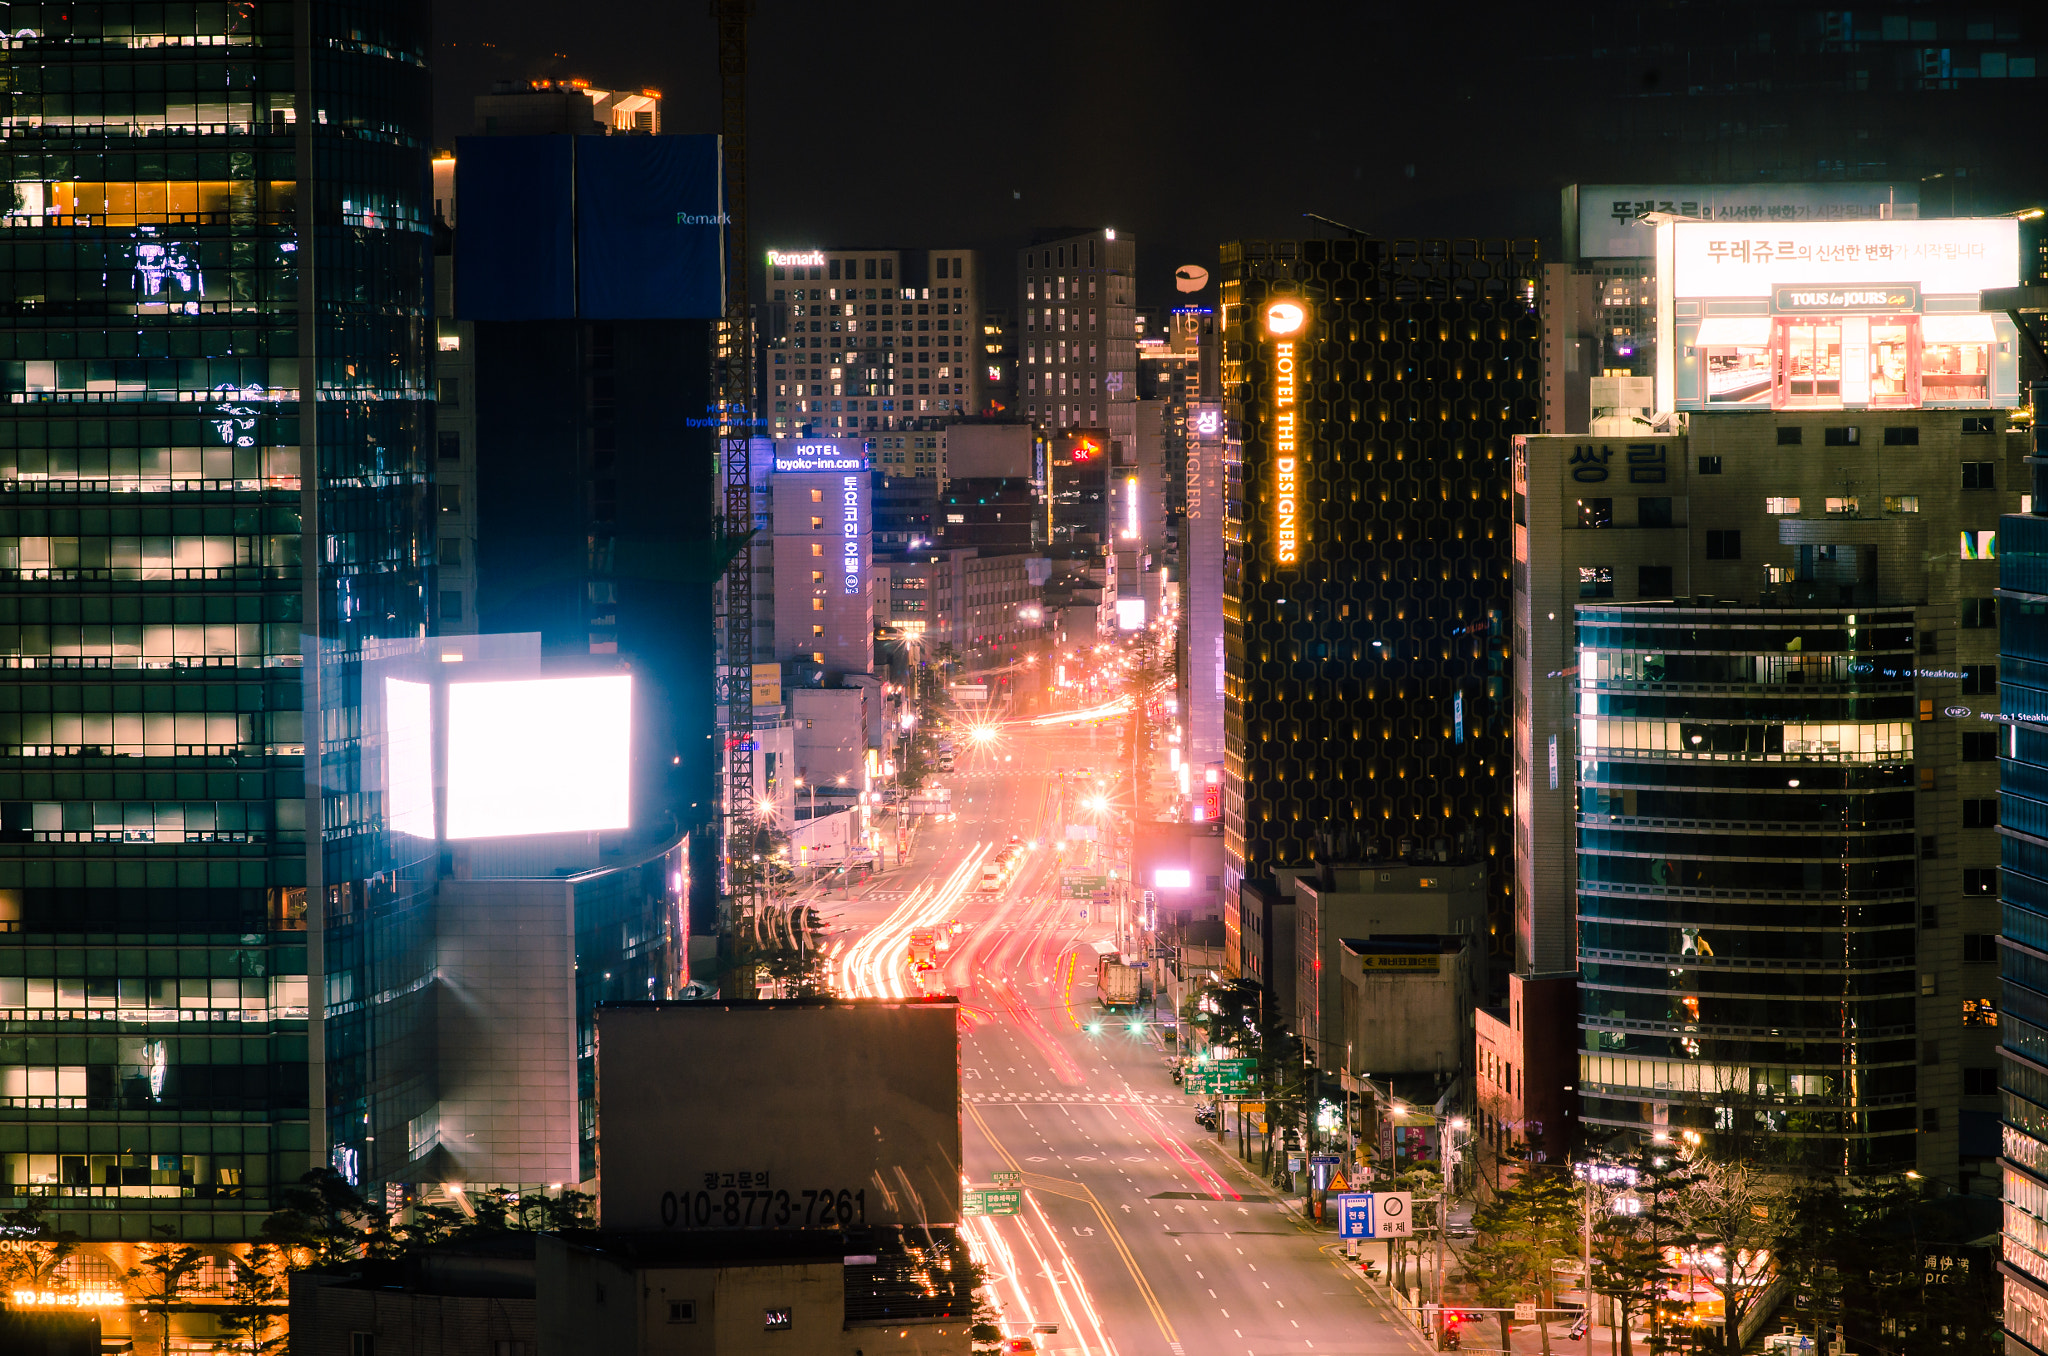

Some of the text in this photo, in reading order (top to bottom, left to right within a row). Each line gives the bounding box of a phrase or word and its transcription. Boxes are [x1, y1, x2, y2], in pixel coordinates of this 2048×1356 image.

[677, 212, 731, 225] Remark
[767, 250, 825, 266] Remark
[1707, 239, 1986, 264] 뚜레쥬르의 신선한 변화가 시작됩니다
[1791, 293, 1828, 306] TOUS
[1829, 292, 1843, 305] les
[1843, 292, 1888, 307] JOURS
[1185, 304, 1201, 519] HOTEL THE DESIGNERS
[797, 445, 841, 456] HOTEL
[1075, 450, 1089, 459] SK
[1278, 343, 1295, 562] HOTEL THE DESIGNERS
[775, 458, 860, 471] toyoko-inn.com
[1568, 444, 1667, 484] 쌍림
[843, 476, 859, 573] 토요코인 호텔
[1920, 669, 1969, 679] Steakhouse
[2017, 713, 2048, 721] Steakh
[1378, 957, 1437, 967] 제비표페인트
[703, 1170, 770, 1191] 광고문의
[660, 1189, 866, 1227] 010-8773-7261
[1348, 1211, 1366, 1220] 전용
[1350, 1222, 1364, 1234] 끝
[1382, 1221, 1405, 1233] 해제
[77, 1291, 125, 1308] JOURS
